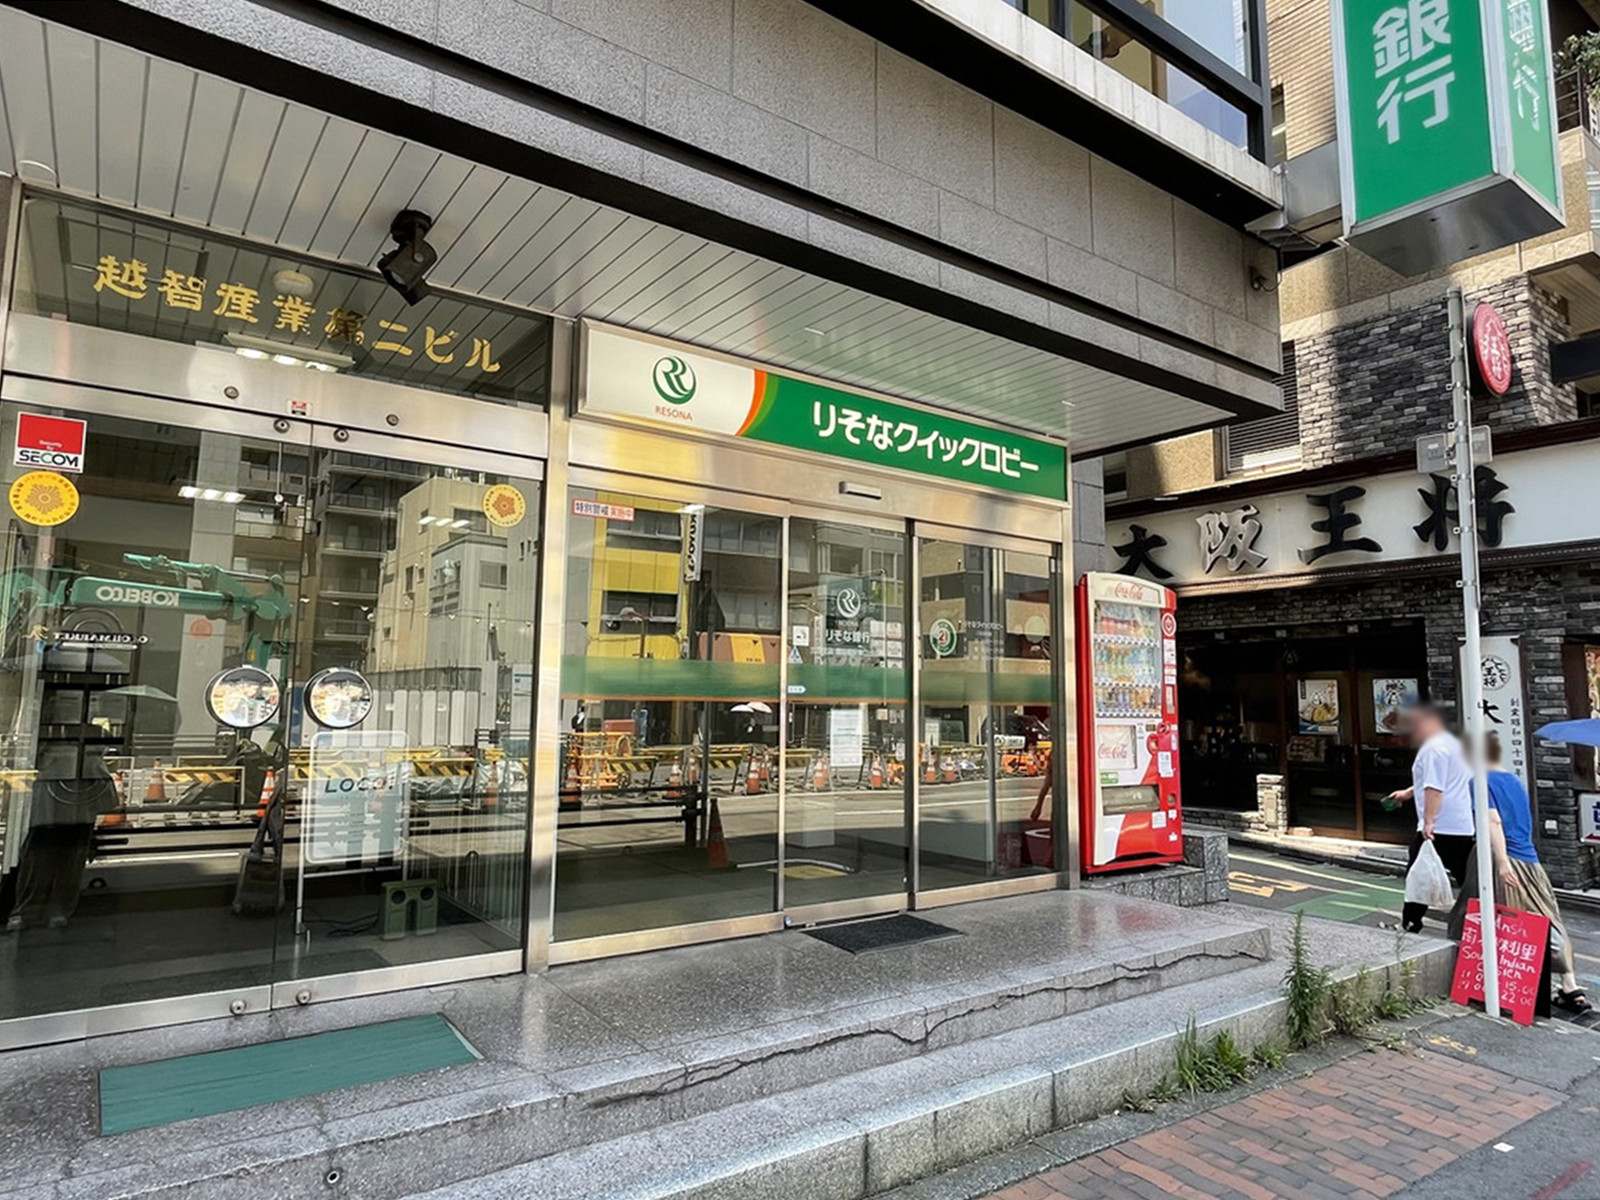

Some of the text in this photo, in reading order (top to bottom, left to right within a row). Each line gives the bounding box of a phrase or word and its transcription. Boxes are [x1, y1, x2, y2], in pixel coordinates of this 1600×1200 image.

[1372, 0, 1456, 145] 銀行
[655, 405, 693, 421] RESONA
[813, 401, 1040, 478] りそなクイックロビー
[19, 449, 79, 468] SECOM
[1112, 465, 1516, 579] 大阪王将
